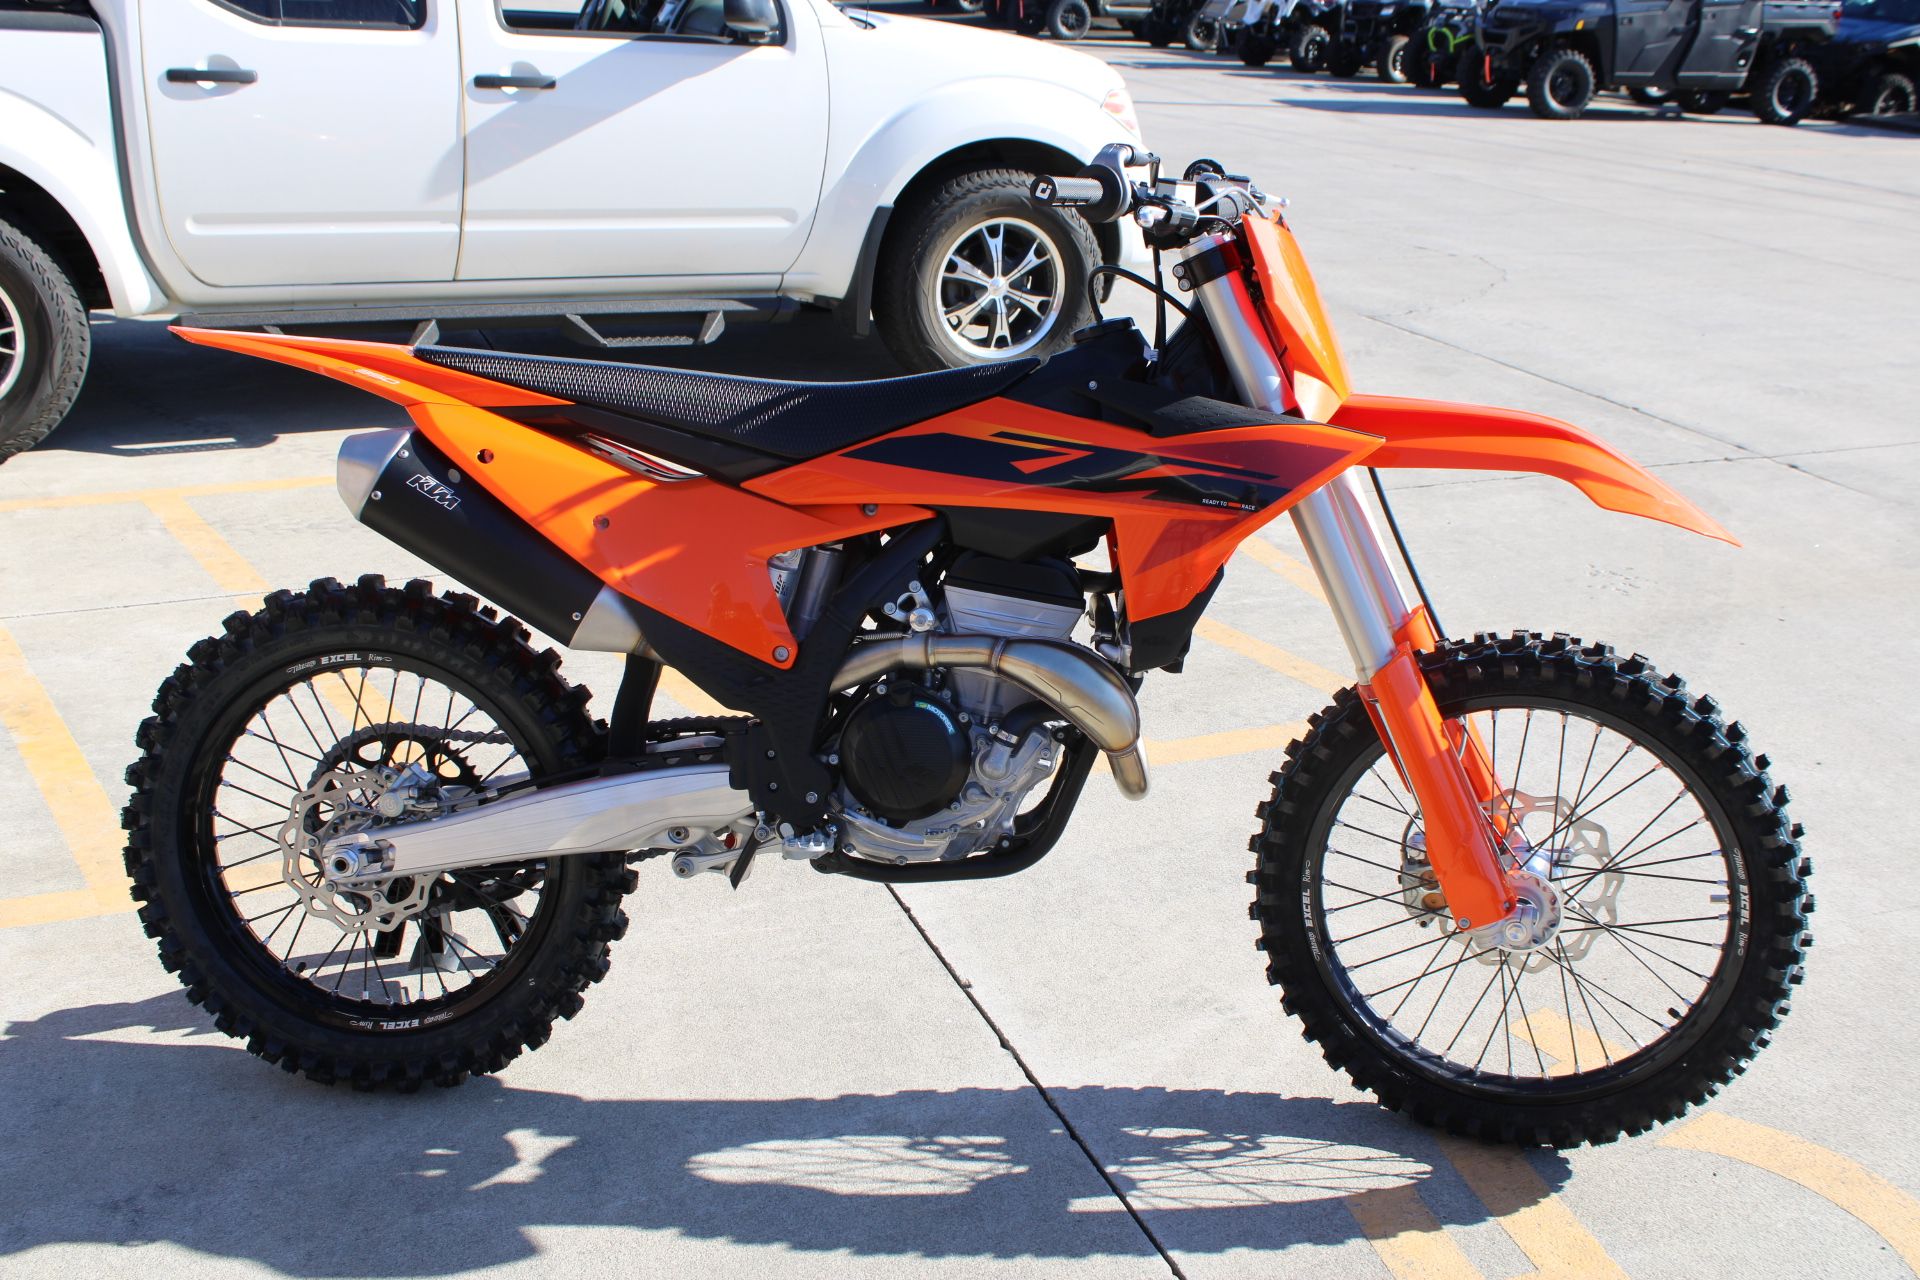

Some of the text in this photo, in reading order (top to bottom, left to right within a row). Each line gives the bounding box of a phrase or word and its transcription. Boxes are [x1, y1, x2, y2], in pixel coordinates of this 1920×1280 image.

[406, 474, 461, 510] KTM
[1202, 498, 1219, 506] READY
[1241, 503, 1256, 511] RACE
[320, 653, 362, 665] EXCEL
[368, 653, 389, 662] Rim
[926, 703, 956, 735] MOTOREX
[1302, 888, 1314, 928] EXCEL
[1739, 884, 1750, 925] EXCEL
[379, 1019, 420, 1030] EXCEL
